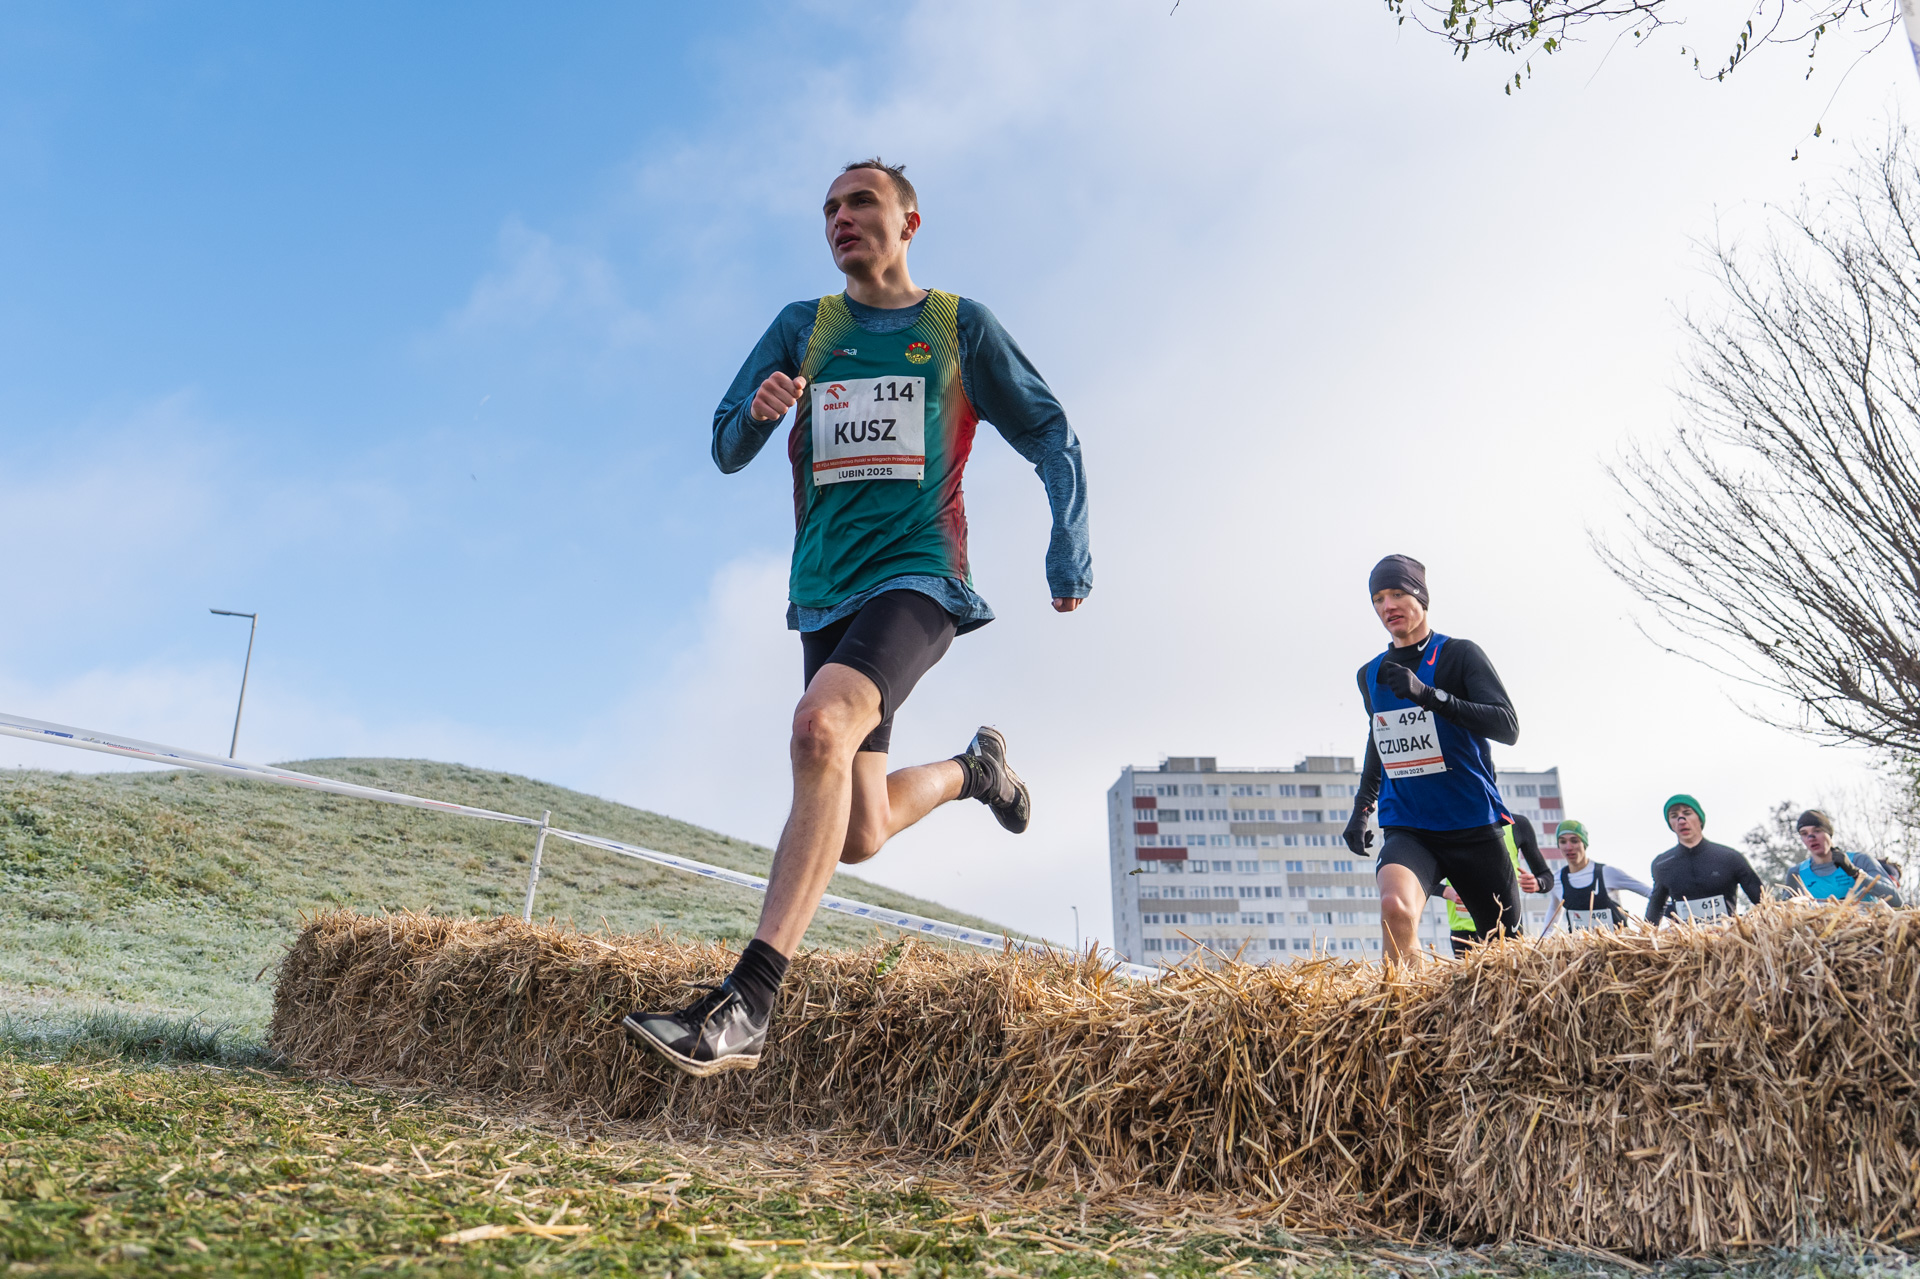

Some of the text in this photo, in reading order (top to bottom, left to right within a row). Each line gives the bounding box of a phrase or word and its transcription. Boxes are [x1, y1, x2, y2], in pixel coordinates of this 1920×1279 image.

[873, 382, 914, 402] 114
[823, 401, 849, 411] ORLEN
[834, 419, 897, 445] KUSZ
[838, 467, 893, 479] LUBIN 2025
[1399, 710, 1427, 726] 494
[1378, 734, 1434, 755] CZUBAK
[1701, 898, 1720, 910] 615
